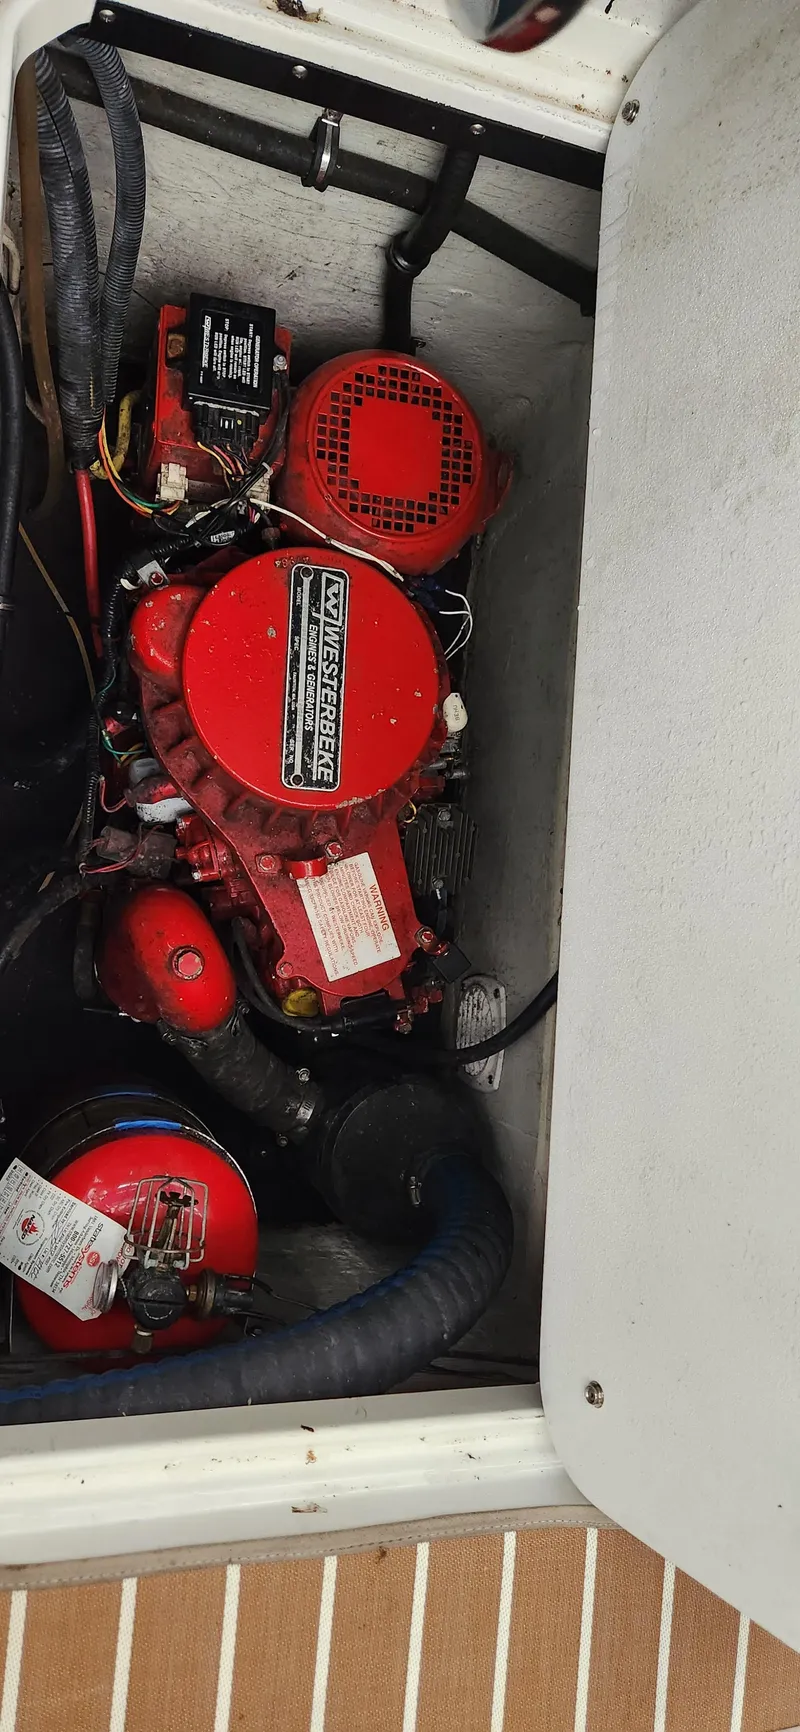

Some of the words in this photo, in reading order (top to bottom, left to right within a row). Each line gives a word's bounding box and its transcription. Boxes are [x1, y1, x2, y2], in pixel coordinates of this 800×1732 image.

[306, 624, 318, 661] ENGINES
[302, 673, 316, 731] GENERATORS
[315, 625, 341, 782] WESTERBEKE
[314, 888, 326, 913] PRODUCT
[322, 913, 334, 939] COMPLIES
[327, 882, 338, 905] BLOWER
[334, 905, 344, 924] BELOW
[328, 906, 334, 914] BY
[333, 867, 343, 888] ENGINE
[340, 887, 356, 925] COMPARTMENT
[352, 925, 360, 937] AND
[333, 885, 341, 897] FOR
[337, 896, 349, 922] GASOLINE
[338, 866, 349, 889] MINUTES
[349, 900, 359, 919] CHECK
[355, 919, 364, 933] BOTH
[343, 864, 354, 887] BLOWER
[350, 887, 358, 898] FOR
[356, 905, 366, 922] LEAST
[362, 922, 370, 937] FOUR
[348, 863, 359, 885] BEFORE
[355, 884, 367, 908] STARTING
[370, 929, 381, 953] OPERATE
[353, 861, 365, 887] GASOLINE
[361, 887, 372, 908] VAPORS
[368, 907, 376, 919] CAN
[368, 883, 390, 931] WARNING
[317, 919, 327, 939] SAFETY
[19, 1213, 35, 1240] NAFED
[53, 1229, 79, 1269] 800-727-5512
[61, 1221, 104, 1289] statesystems
